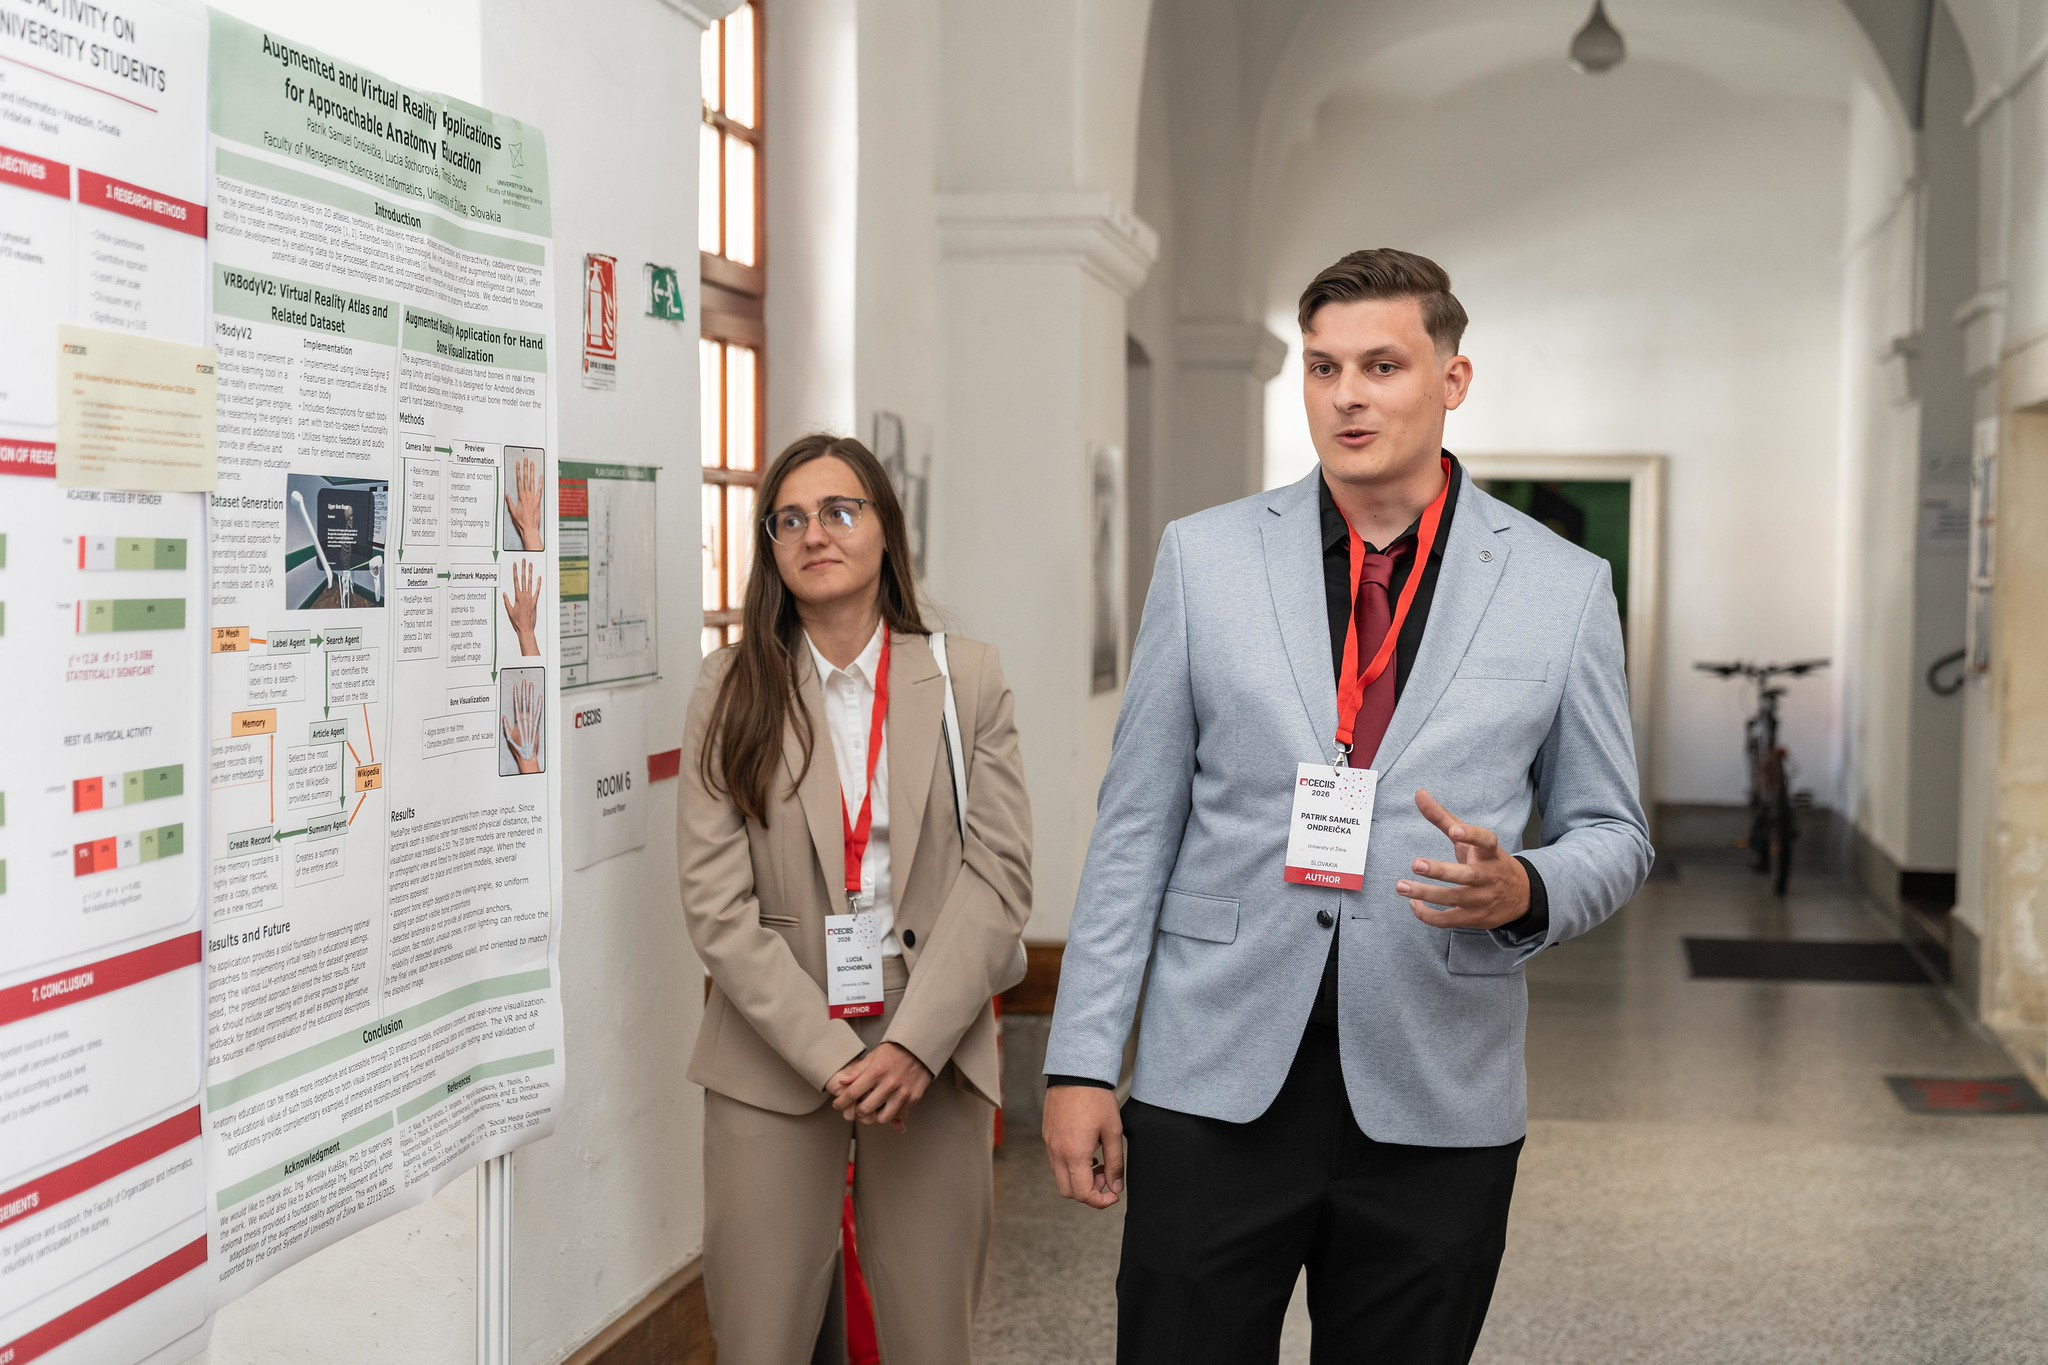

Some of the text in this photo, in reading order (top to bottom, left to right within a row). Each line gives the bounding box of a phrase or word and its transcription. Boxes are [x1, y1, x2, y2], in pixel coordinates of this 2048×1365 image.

[113, 15, 135, 43] ON
[0, 11, 166, 93] NIVERSITY STUDENTS
[263, 34, 335, 82] Augmented
[339, 70, 358, 93] and
[361, 77, 398, 110] Virtual
[403, 94, 437, 130] Reality
[285, 78, 304, 103] for
[308, 88, 383, 137] Approachable
[386, 122, 437, 160] Anatomy
[307, 118, 326, 136] Patrik
[328, 126, 352, 146] Samuel
[354, 136, 383, 163] Ondreička,
[385, 150, 403, 166] Lucia
[404, 156, 441, 179] Sochorová,
[451, 175, 466, 191] Socha
[0, 155, 46, 180] JECTIVES
[264, 131, 292, 154] Faculty
[295, 142, 303, 155] of
[305, 144, 348, 171] Management
[349, 160, 373, 180] Science
[374, 172, 384, 185] and
[385, 175, 425, 200] Informatics,
[470, 205, 501, 223] Slovakia
[497, 179, 518, 191] UNIVERSITY
[113, 186, 152, 210] RESEARCH
[152, 199, 187, 221] METHODS
[486, 186, 501, 196] Faculty
[507, 190, 529, 202] Management
[529, 195, 543, 205] Science
[512, 200, 530, 210] Informatics
[374, 201, 422, 230] Introduction
[223, 271, 388, 319] VRBodyV2: Virtual Reality Atlas and
[271, 306, 345, 333] Related Dataset
[405, 310, 543, 350] Augmented Reality Application for Hand
[303, 338, 353, 356] Implementation
[436, 340, 494, 363] Bone Visualization
[304, 358, 338, 373] Implemented
[340, 364, 354, 376] using
[355, 365, 369, 377] Unreal
[370, 368, 386, 380] Engine
[400, 412, 424, 426] Methods
[405, 442, 421, 451] Camera
[464, 443, 485, 453] Preview
[456, 455, 494, 465] Transformation
[66, 489, 162, 506] ACADEMIC STRESS BY GENDER
[211, 496, 283, 510] Dataset Generation
[401, 567, 433, 575] Hand Landmark
[475, 572, 497, 582] Mapping
[407, 579, 428, 587] Detection
[217, 628, 239, 639] 3D Mesh
[326, 633, 360, 645] Search Agent
[220, 642, 236, 651] labels
[272, 637, 306, 649] Label Agent
[66, 664, 155, 682] STATISTICALLY SIGNIFICANT
[459, 695, 490, 705] Visualization
[242, 719, 265, 729] Memory
[64, 735, 81, 747] REST
[94, 730, 124, 742] PHYSICAL
[126, 726, 153, 738] ACTIVITY
[312, 727, 345, 739] Article Agent
[357, 768, 380, 778] Wikipedia
[364, 780, 373, 788] API
[596, 771, 631, 799] ROOM 6
[1308, 779, 1335, 789] CECIIS
[391, 807, 415, 823] Results
[602, 807, 617, 817] Ground
[1301, 812, 1360, 826] PATRIK SAMUEL
[308, 819, 347, 835] Summary Agent
[1307, 823, 1351, 835] ONDREIČKA
[229, 835, 271, 850] Create Record
[1311, 860, 1338, 868] SLOVAKIA
[1305, 872, 1341, 884] AUTHOR
[208, 920, 291, 953] Results and Future
[40, 971, 94, 1001] CONCLUSION
[503, 997, 546, 1012] visualization.
[843, 1005, 870, 1015] AUTHOR
[490, 1009, 539, 1026] The VR and AR
[362, 1017, 404, 1044] Conclusion
[447, 1075, 471, 1094] References
[284, 1141, 340, 1177] Acknowledgment
[0, 1191, 40, 1222] GEMENTS
[310, 1215, 336, 1235] University
[336, 1211, 342, 1221] of
[357, 1201, 366, 1211] No.
